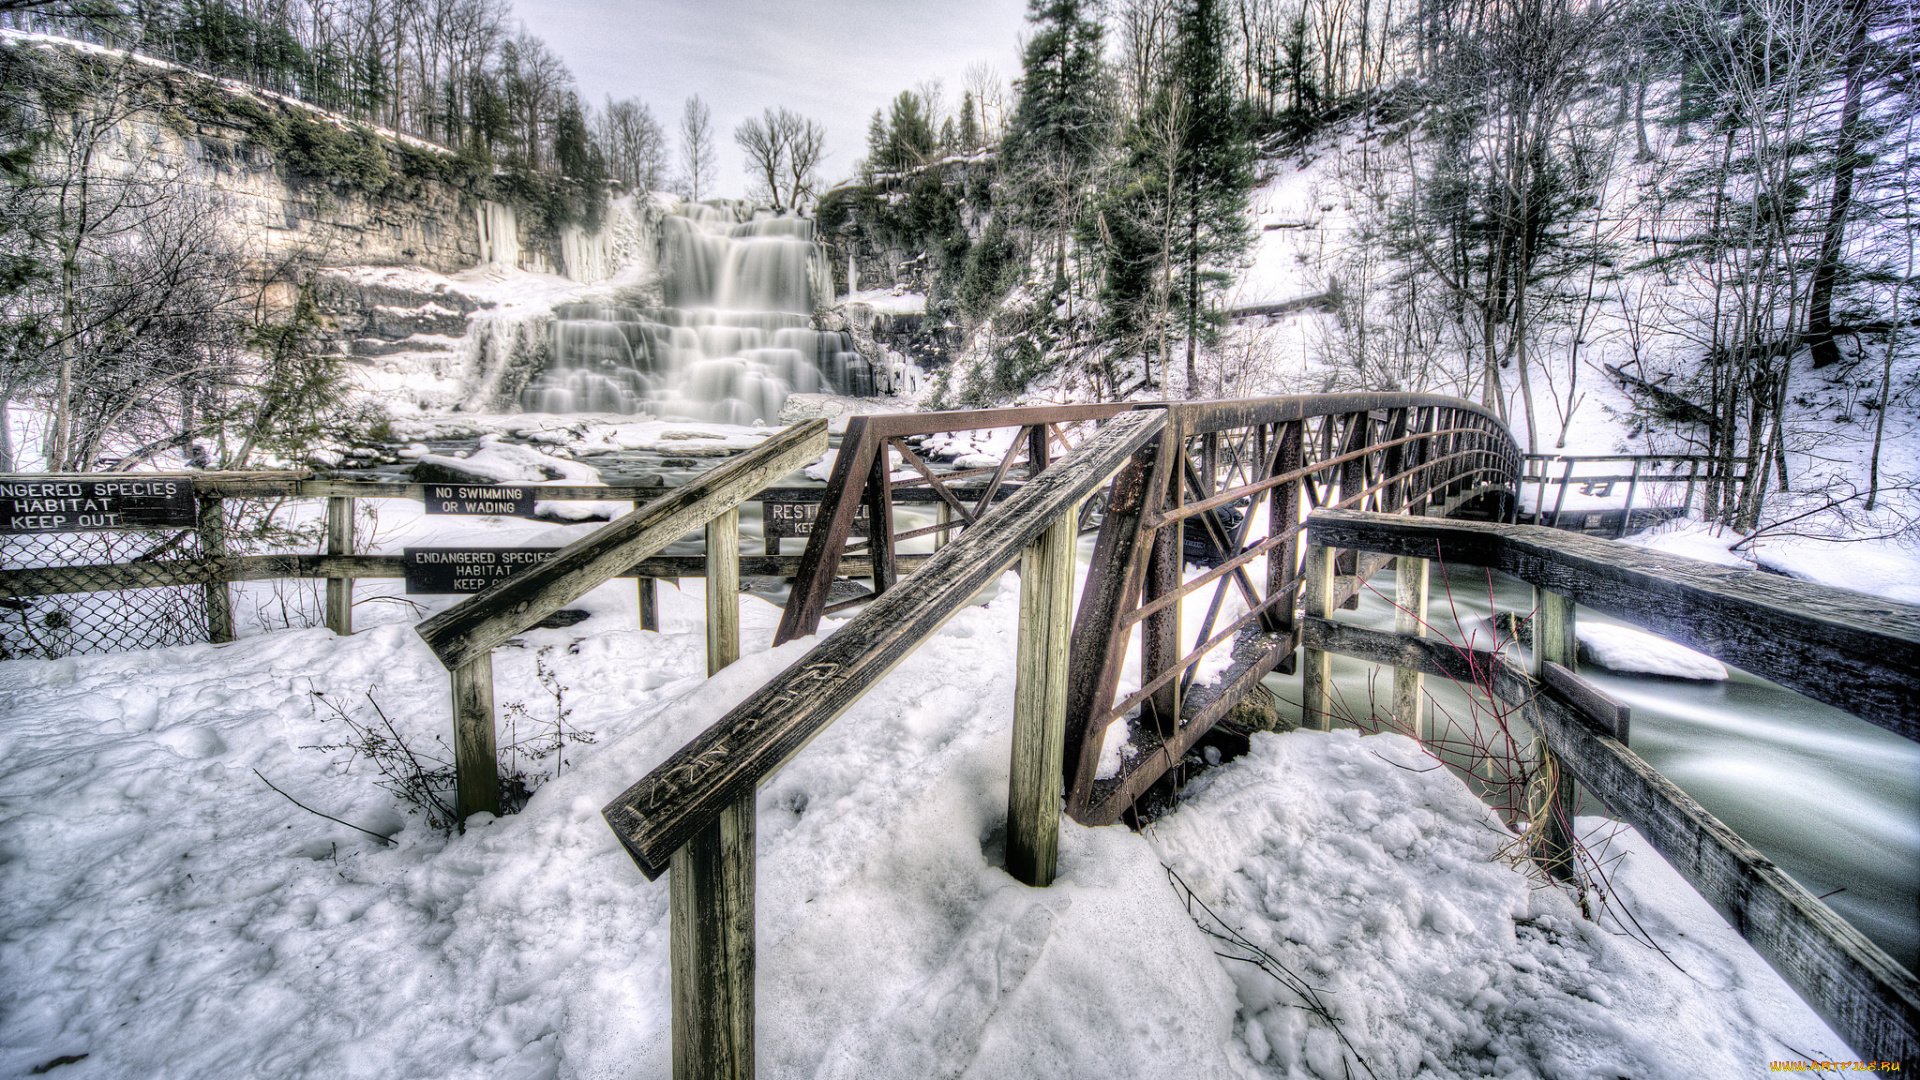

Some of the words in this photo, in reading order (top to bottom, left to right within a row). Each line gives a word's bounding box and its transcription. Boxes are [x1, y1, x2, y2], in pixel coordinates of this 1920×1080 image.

[94, 482, 177, 496] SPECIES
[436, 487, 453, 498] NO
[458, 488, 523, 500] SWIMMING
[15, 498, 112, 512] HABITAT
[442, 502, 459, 513] OR
[465, 502, 515, 513] WADING
[11, 515, 66, 529] KEEP
[78, 514, 119, 527] OUT
[415, 552, 496, 564] ENDANGERED
[456, 565, 512, 576] HABITAT
[453, 579, 486, 590] KEEP
